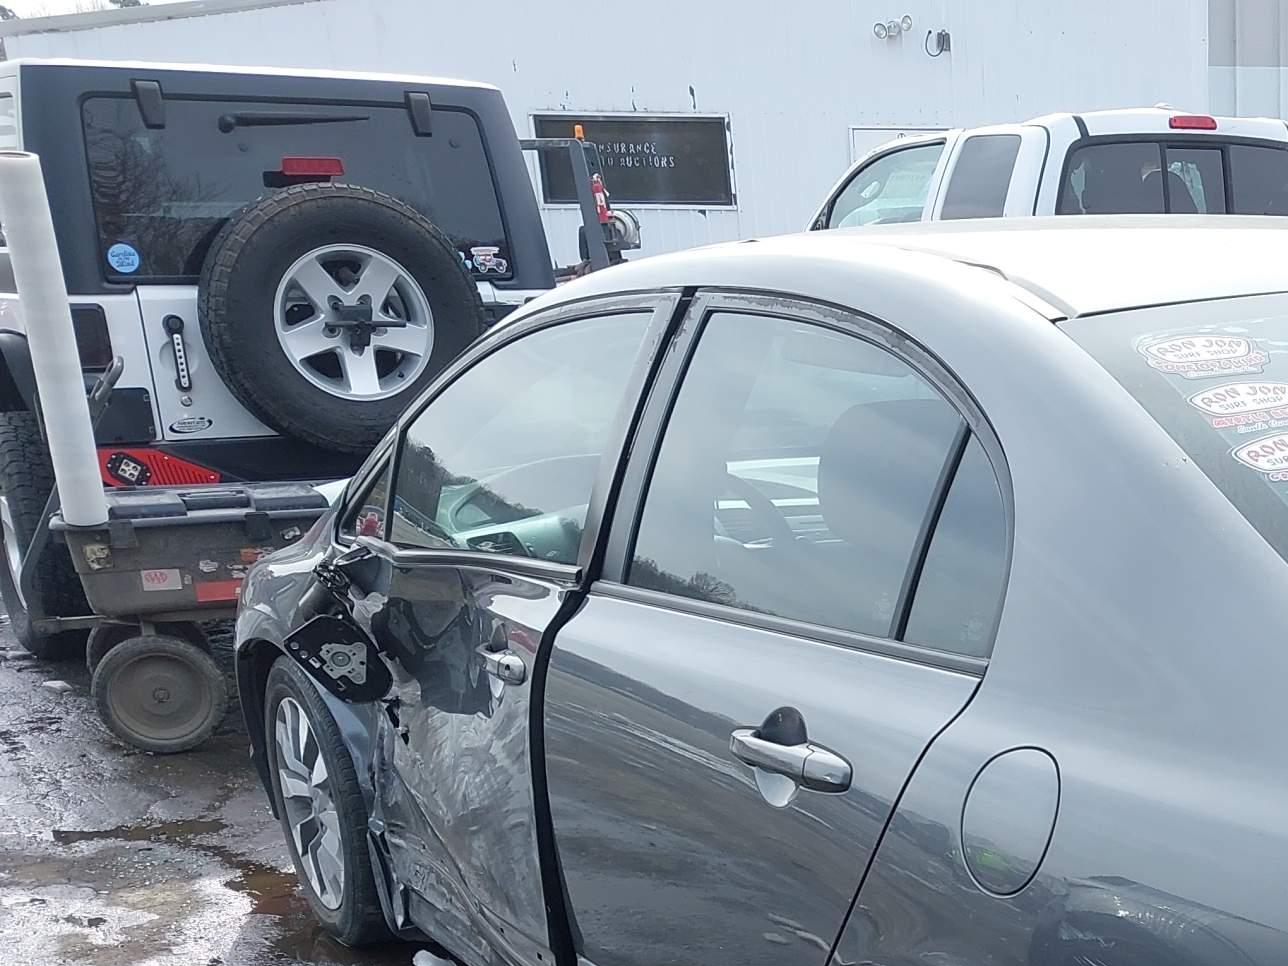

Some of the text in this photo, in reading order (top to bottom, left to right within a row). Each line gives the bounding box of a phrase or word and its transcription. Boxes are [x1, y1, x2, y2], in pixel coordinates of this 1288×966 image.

[598, 142, 657, 154] NSURANCE
[1157, 338, 1242, 356] RON JON
[1174, 348, 1238, 360] SURF SHOP
[1201, 385, 1287, 408] RON JON
[1219, 394, 1283, 411] SURF SHOP
